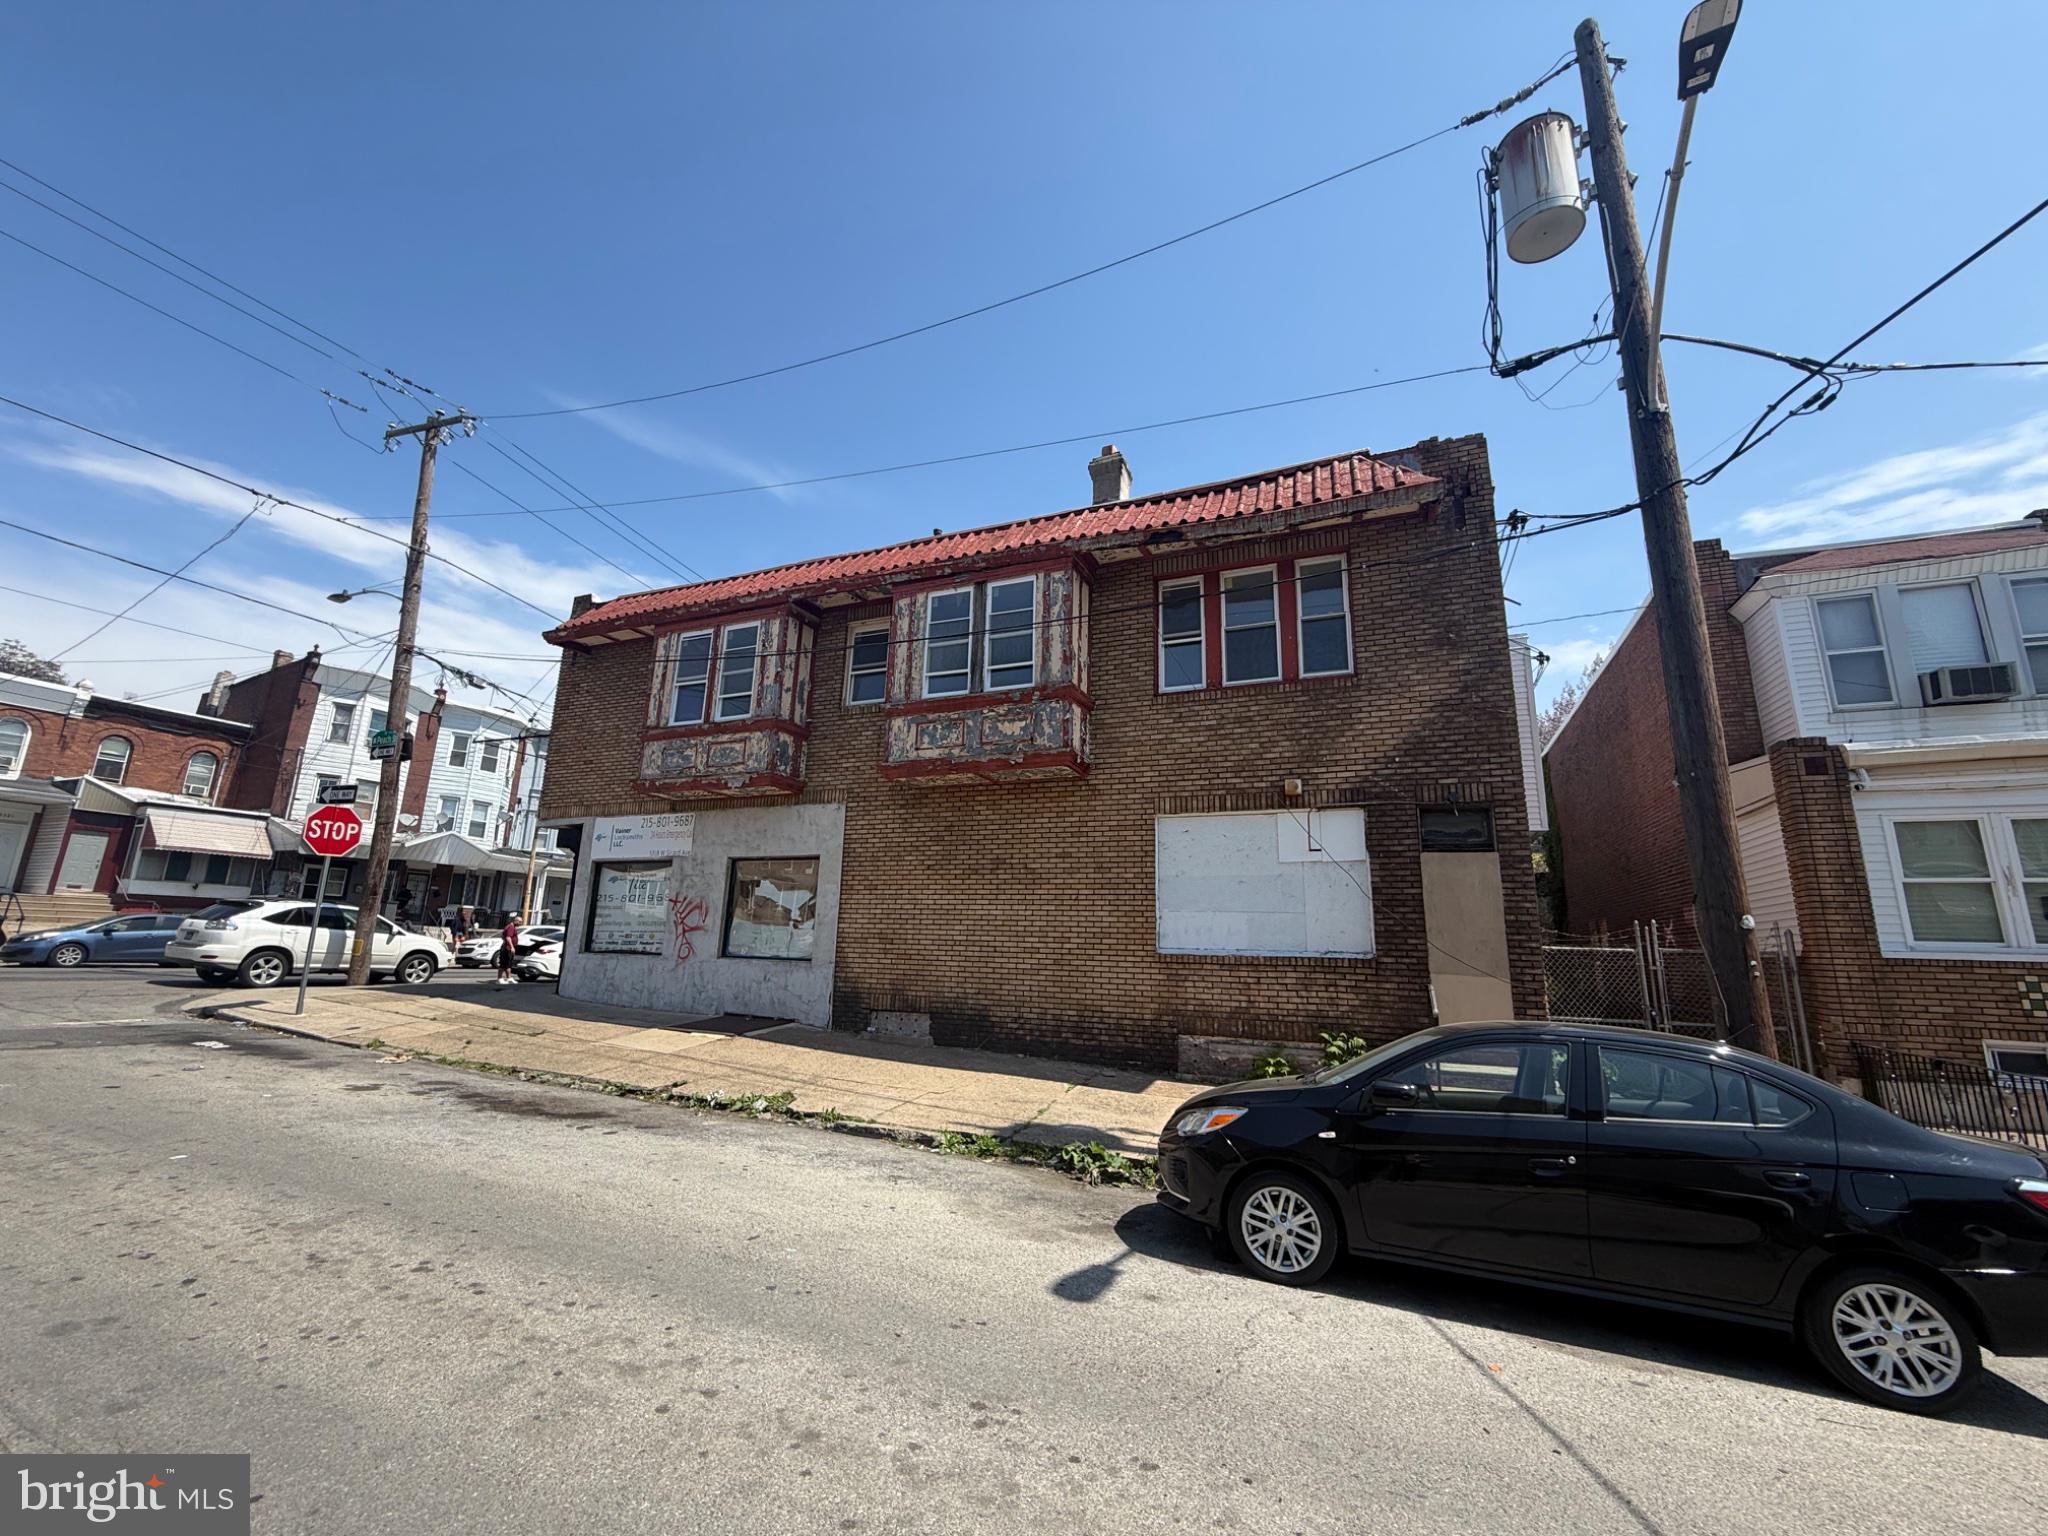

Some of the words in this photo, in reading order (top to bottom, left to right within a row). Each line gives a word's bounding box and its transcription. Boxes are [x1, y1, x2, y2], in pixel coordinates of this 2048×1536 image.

[329, 792, 341, 800] ONE
[341, 790, 353, 799] WAY
[308, 819, 359, 841] STOP
